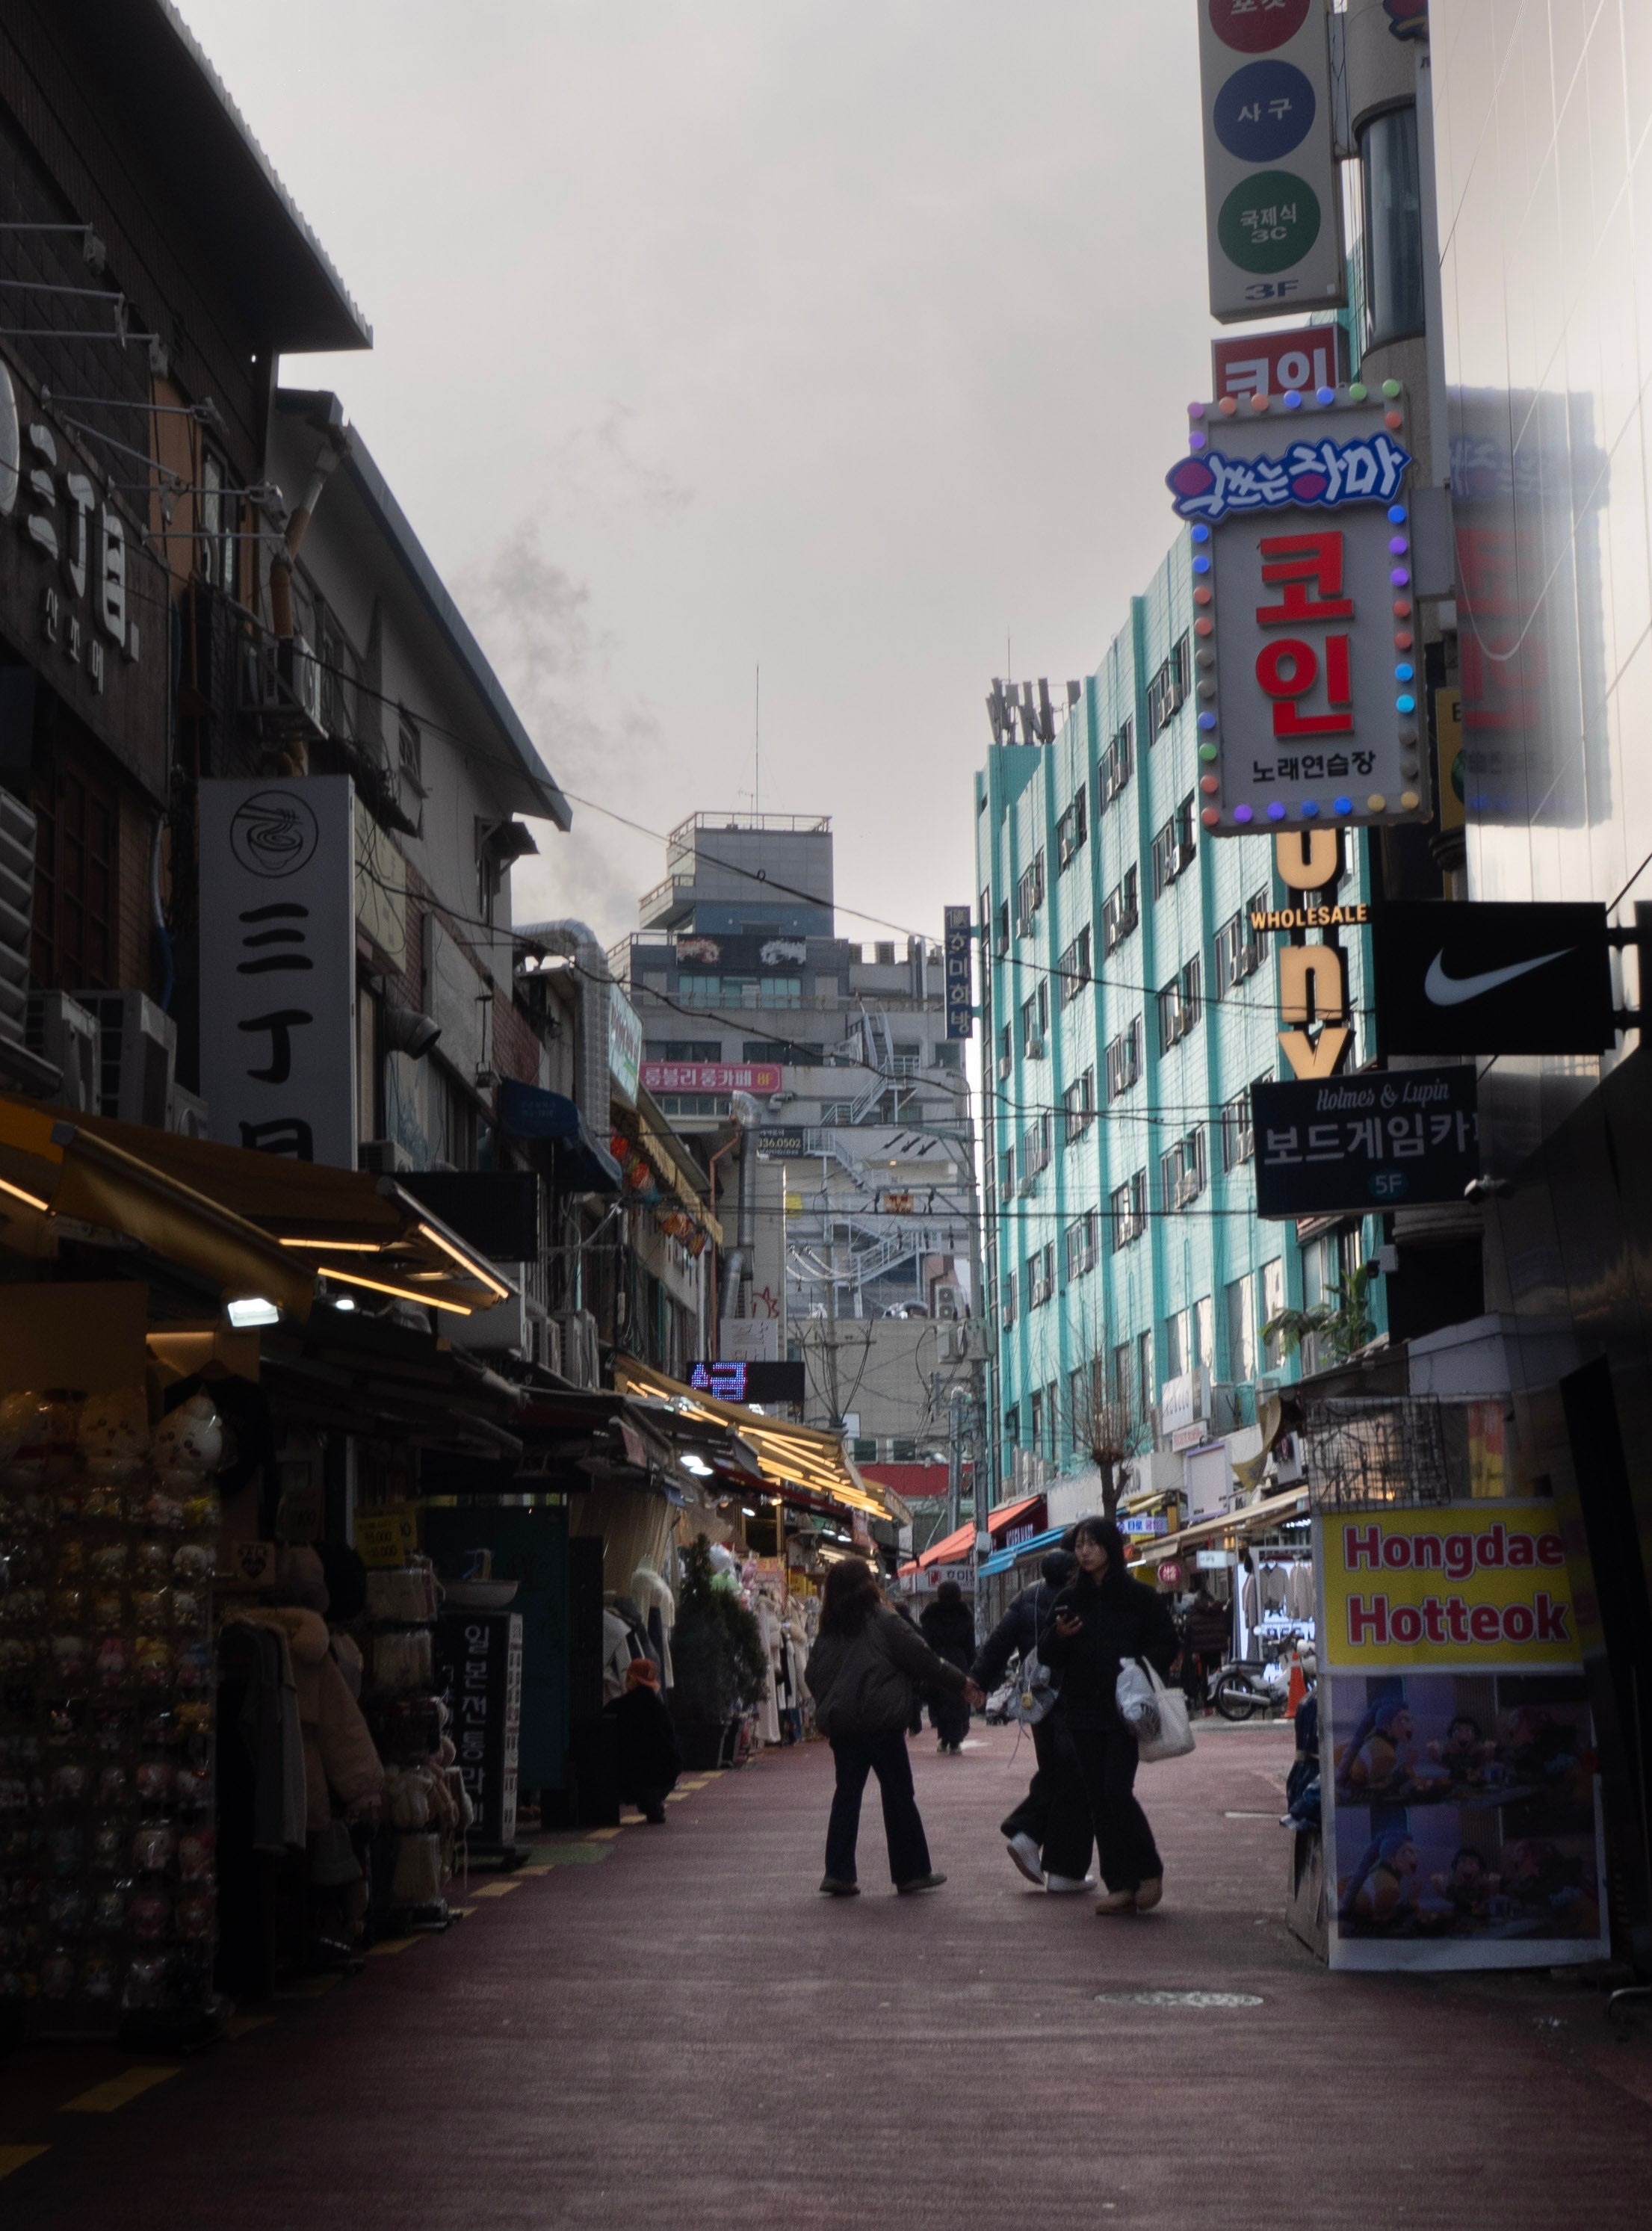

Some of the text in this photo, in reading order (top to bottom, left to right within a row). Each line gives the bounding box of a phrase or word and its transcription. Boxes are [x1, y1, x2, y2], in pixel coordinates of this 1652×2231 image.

[1237, 98, 1293, 123] 사구
[1240, 202, 1297, 230] 국제식
[1251, 226, 1287, 244] 3C
[1245, 279, 1299, 300] 3F
[1255, 530, 1354, 737] 코인
[1252, 750, 1376, 784] 노래연습장
[1250, 903, 1368, 931] WHOLESALE
[948, 932, 971, 1035] 호미화방
[1316, 1077, 1451, 1112] Holmes & Lupin
[1263, 1110, 1479, 1166] 보드게임카
[1375, 1173, 1402, 1195] 5F
[1345, 1523, 1565, 1579] Hongdae
[1347, 1594, 1570, 1644] Hotteok
